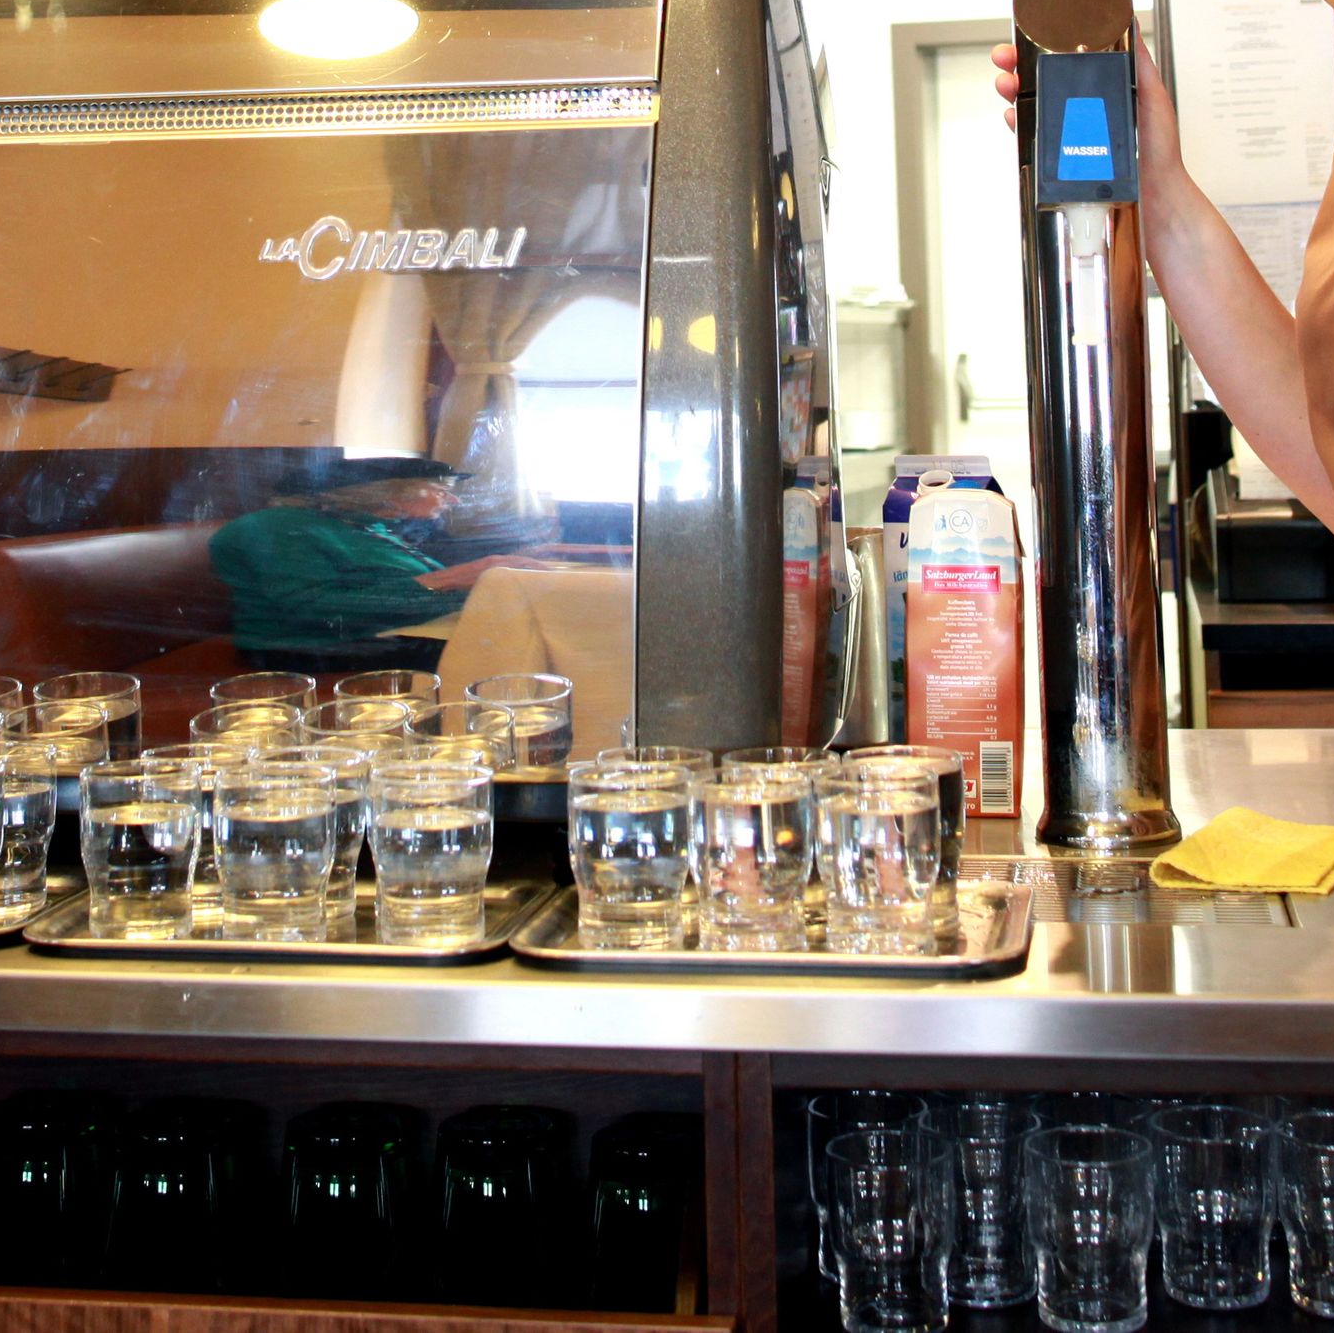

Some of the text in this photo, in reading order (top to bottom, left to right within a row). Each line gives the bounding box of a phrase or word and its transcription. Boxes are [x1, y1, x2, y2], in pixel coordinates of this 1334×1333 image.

[1062, 146, 1108, 156] WASSER
[258, 215, 528, 280] LA CIMBALI
